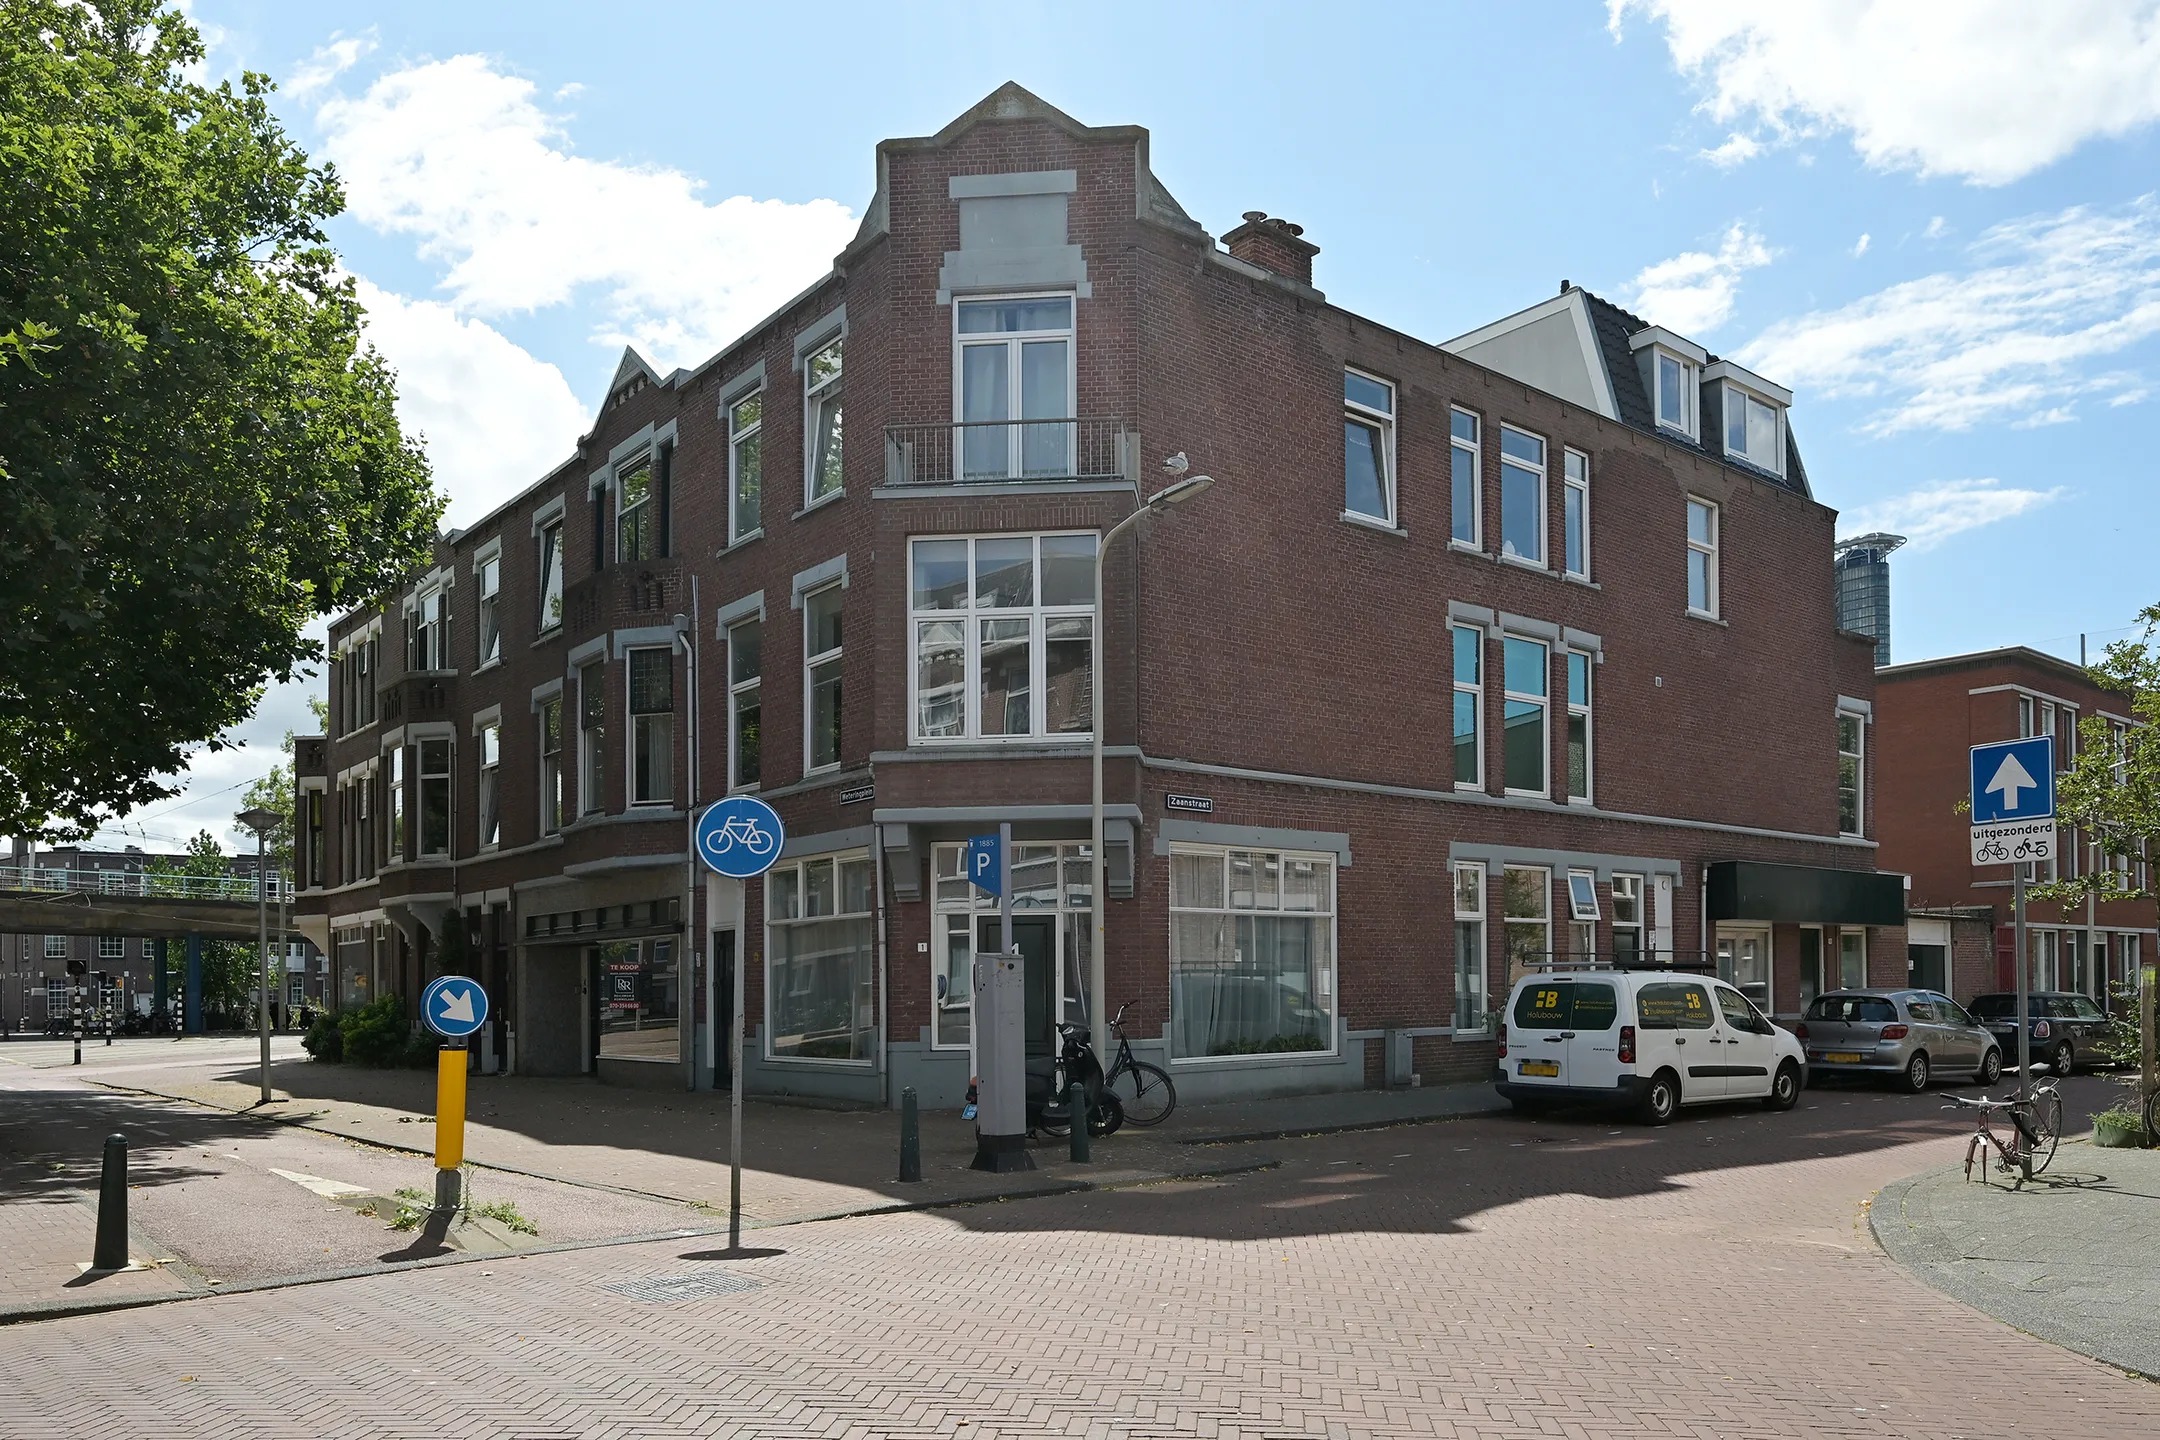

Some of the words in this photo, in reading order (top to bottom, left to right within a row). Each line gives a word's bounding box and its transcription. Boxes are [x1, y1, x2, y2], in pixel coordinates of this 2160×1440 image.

[1170, 797, 1210, 809] Zaanstraat
[1973, 822, 2053, 841] uitgezonderd
[979, 839, 995, 847] 1885
[977, 852, 990, 877] P
